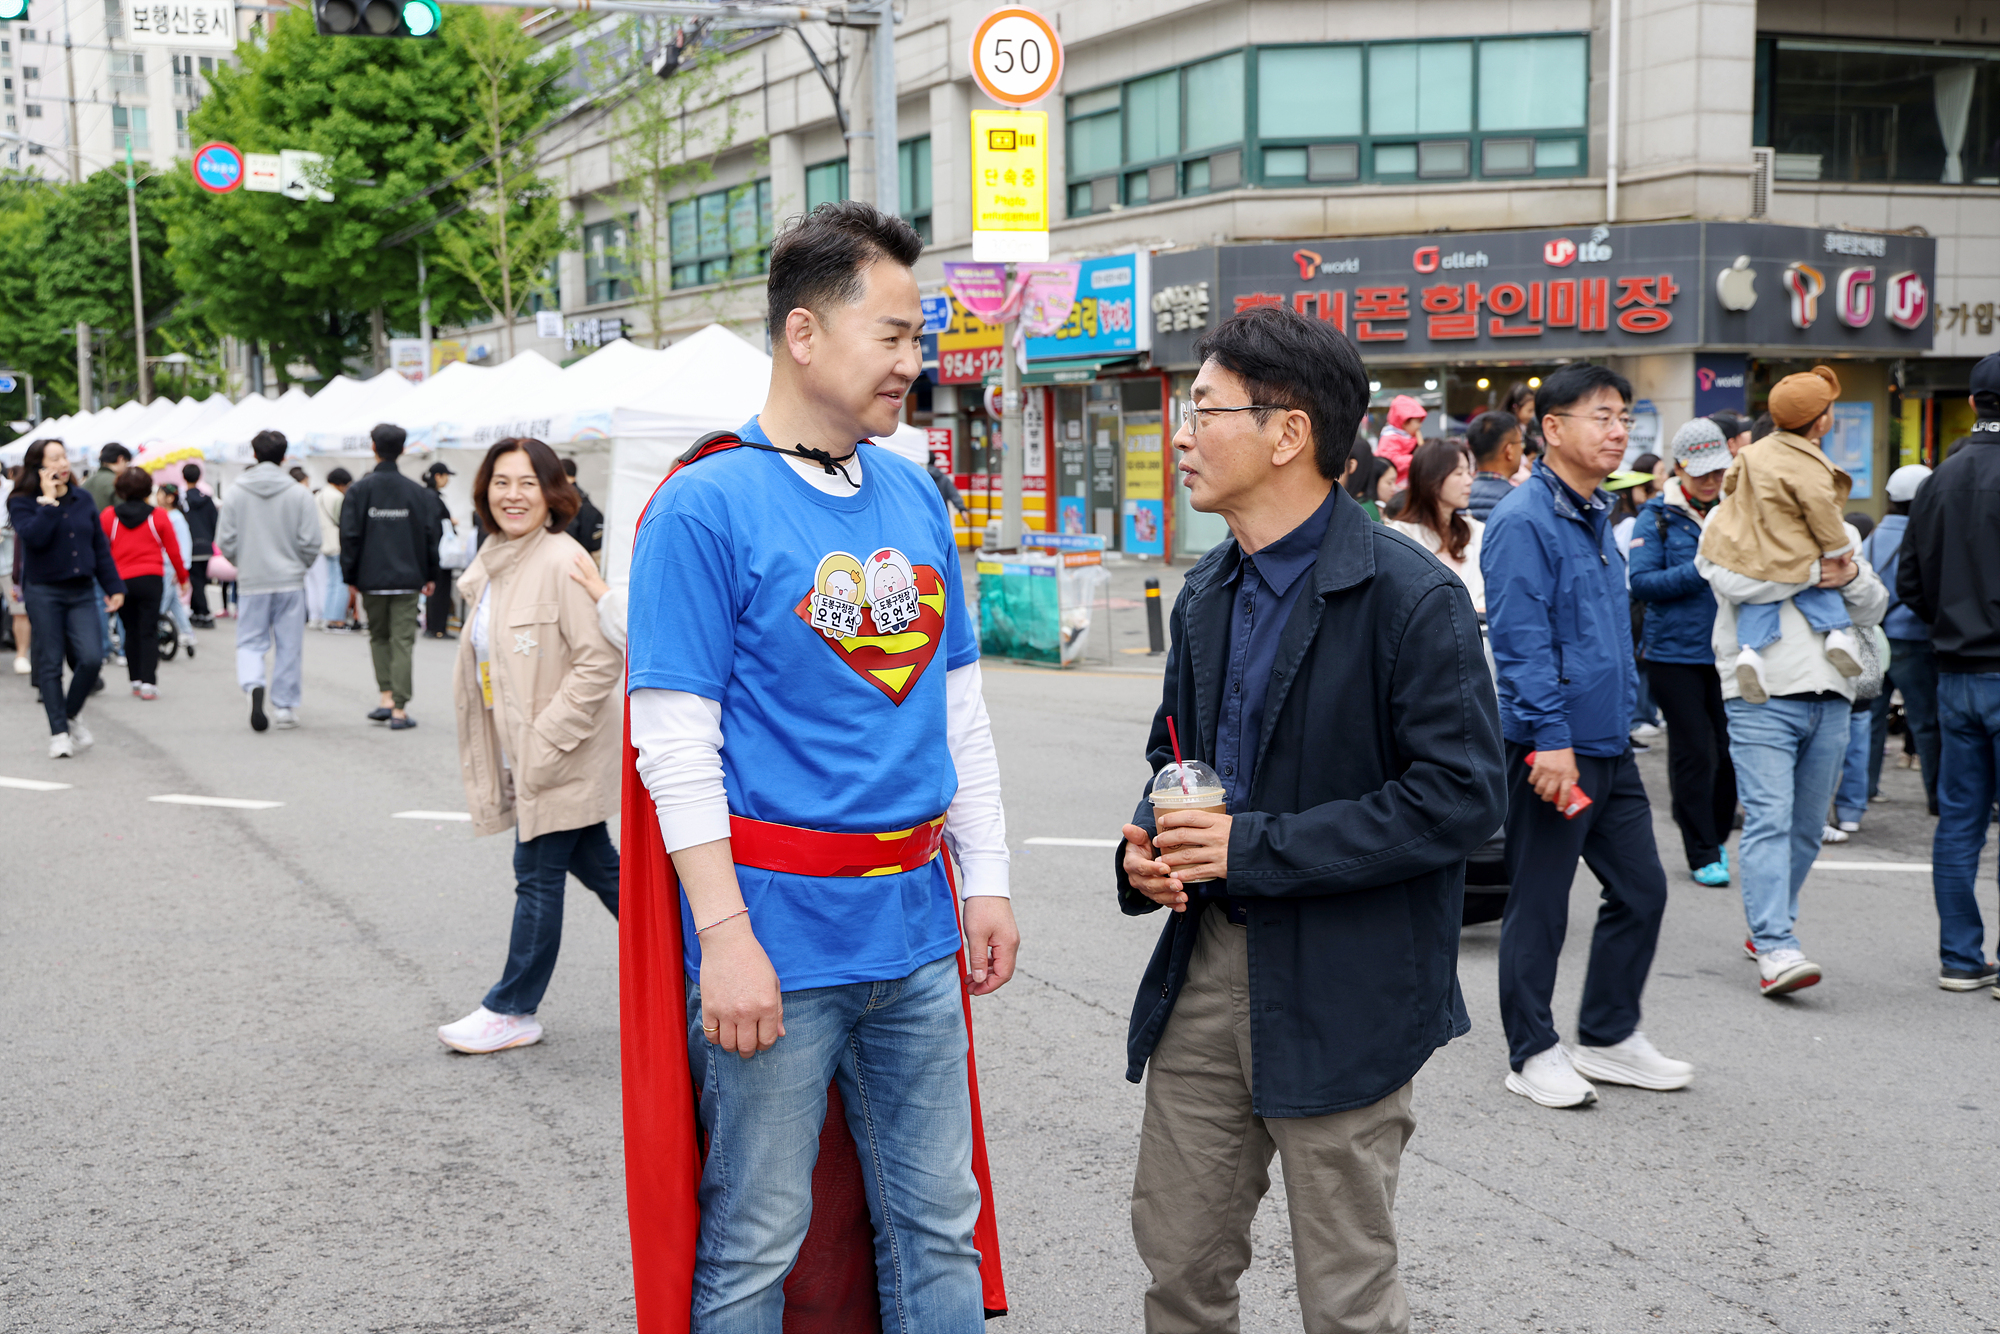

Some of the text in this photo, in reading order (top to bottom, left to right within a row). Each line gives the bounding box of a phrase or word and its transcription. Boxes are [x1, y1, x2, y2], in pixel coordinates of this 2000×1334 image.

[133, 8, 229, 36] 보행신호시
[993, 38, 1042, 74] 50
[994, 195, 1027, 207] Photo
[1321, 257, 1359, 275] world
[943, 348, 1004, 379] 954-12
[821, 597, 855, 615] 도봉구청장
[879, 591, 911, 611] 도봉구청장
[816, 607, 856, 631] 오언석
[880, 601, 917, 627] 오언석
